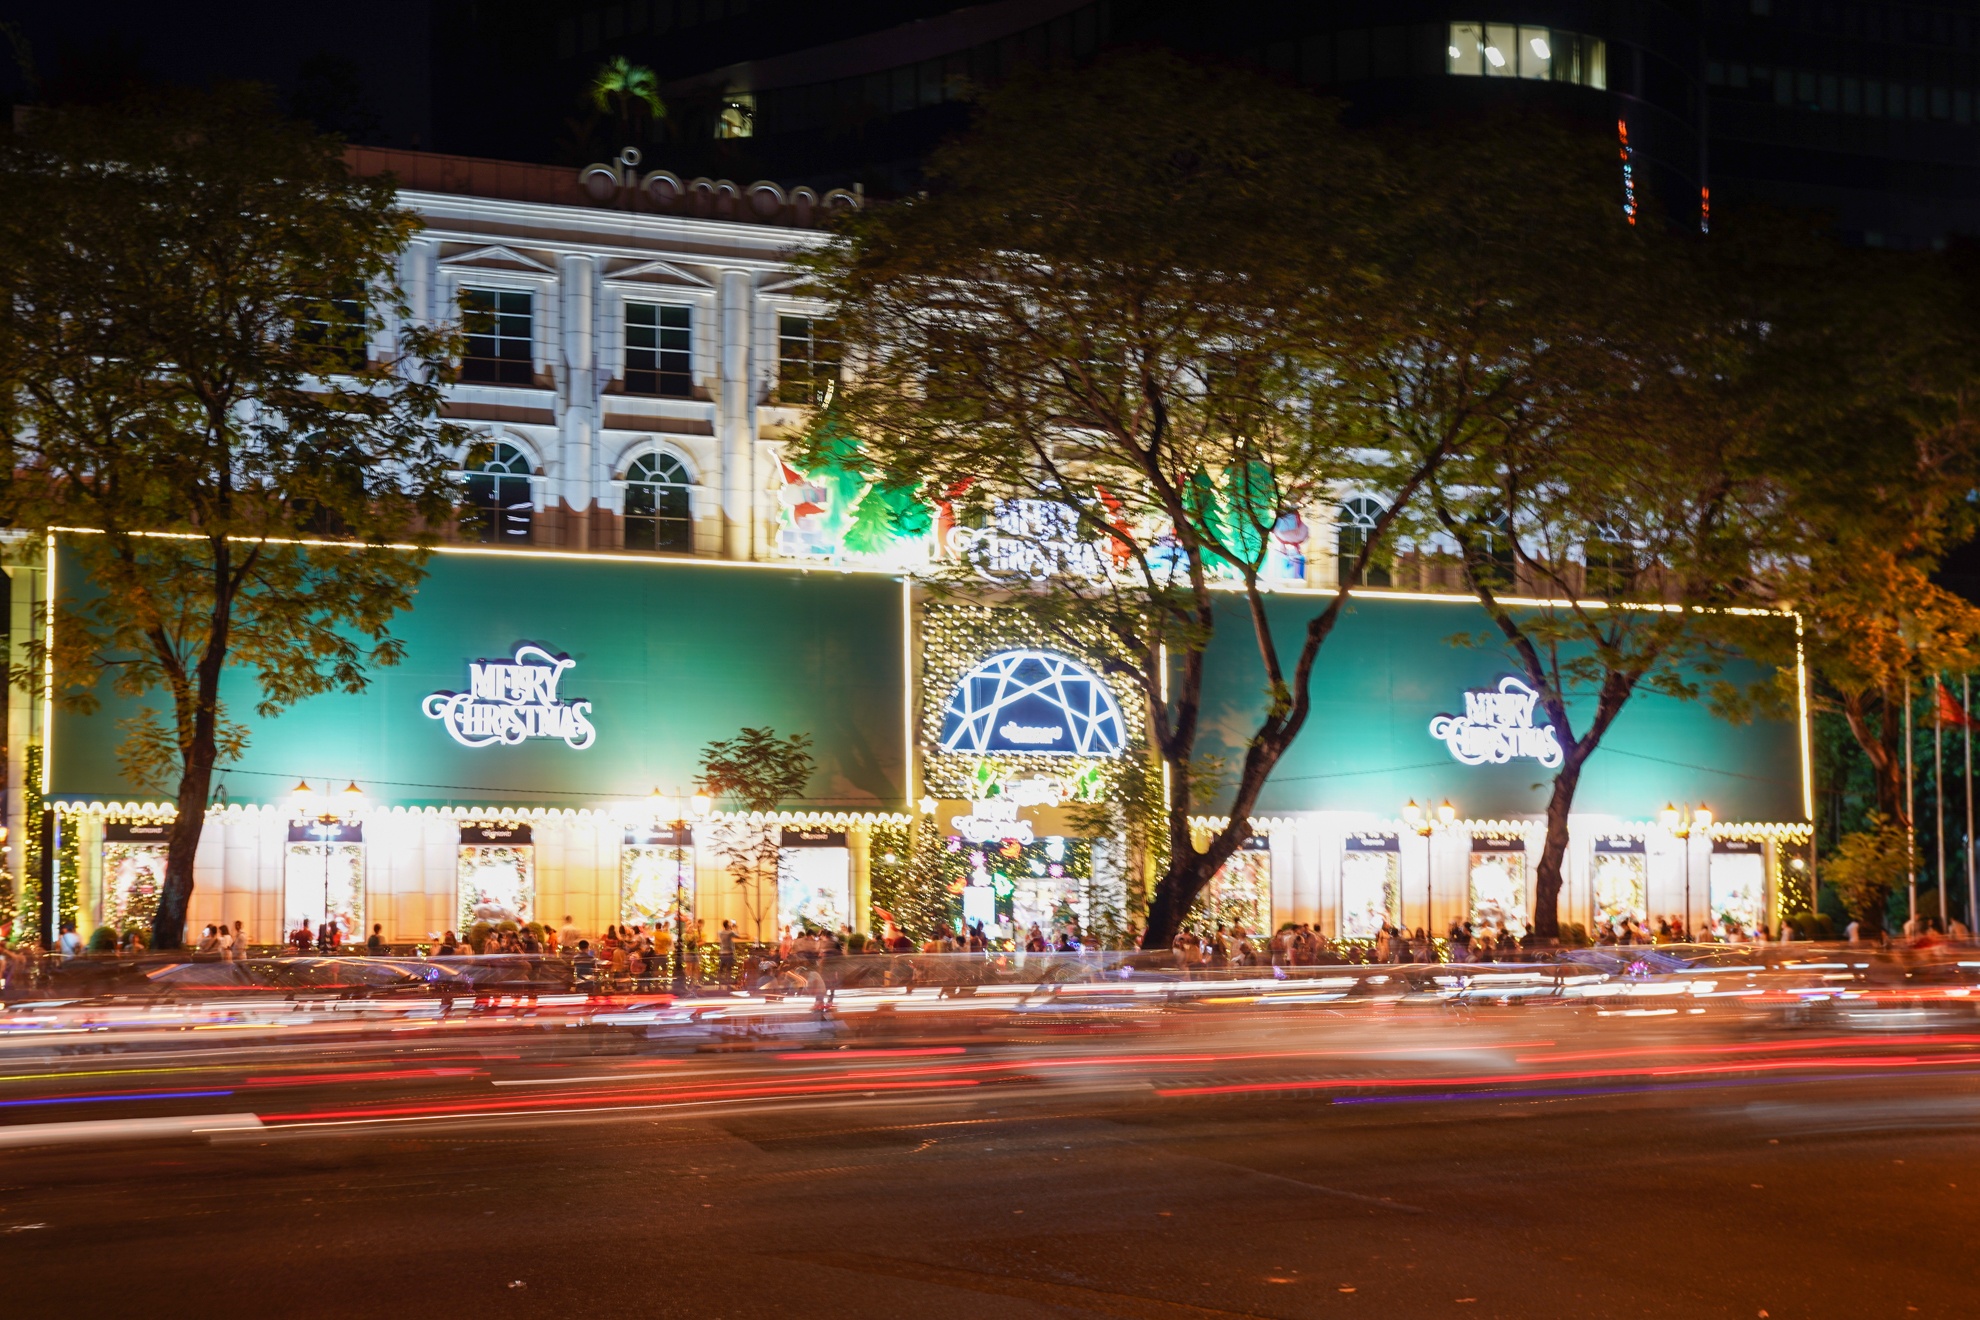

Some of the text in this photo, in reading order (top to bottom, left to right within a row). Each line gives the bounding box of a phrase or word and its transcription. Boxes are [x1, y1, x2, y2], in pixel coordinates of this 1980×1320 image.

[578, 146, 865, 222] diamond
[471, 646, 576, 708] MERRY
[1464, 677, 1539, 728] MERRY
[422, 693, 596, 749] CHRISTMAS
[1430, 716, 1563, 768] CHRISTMAS
